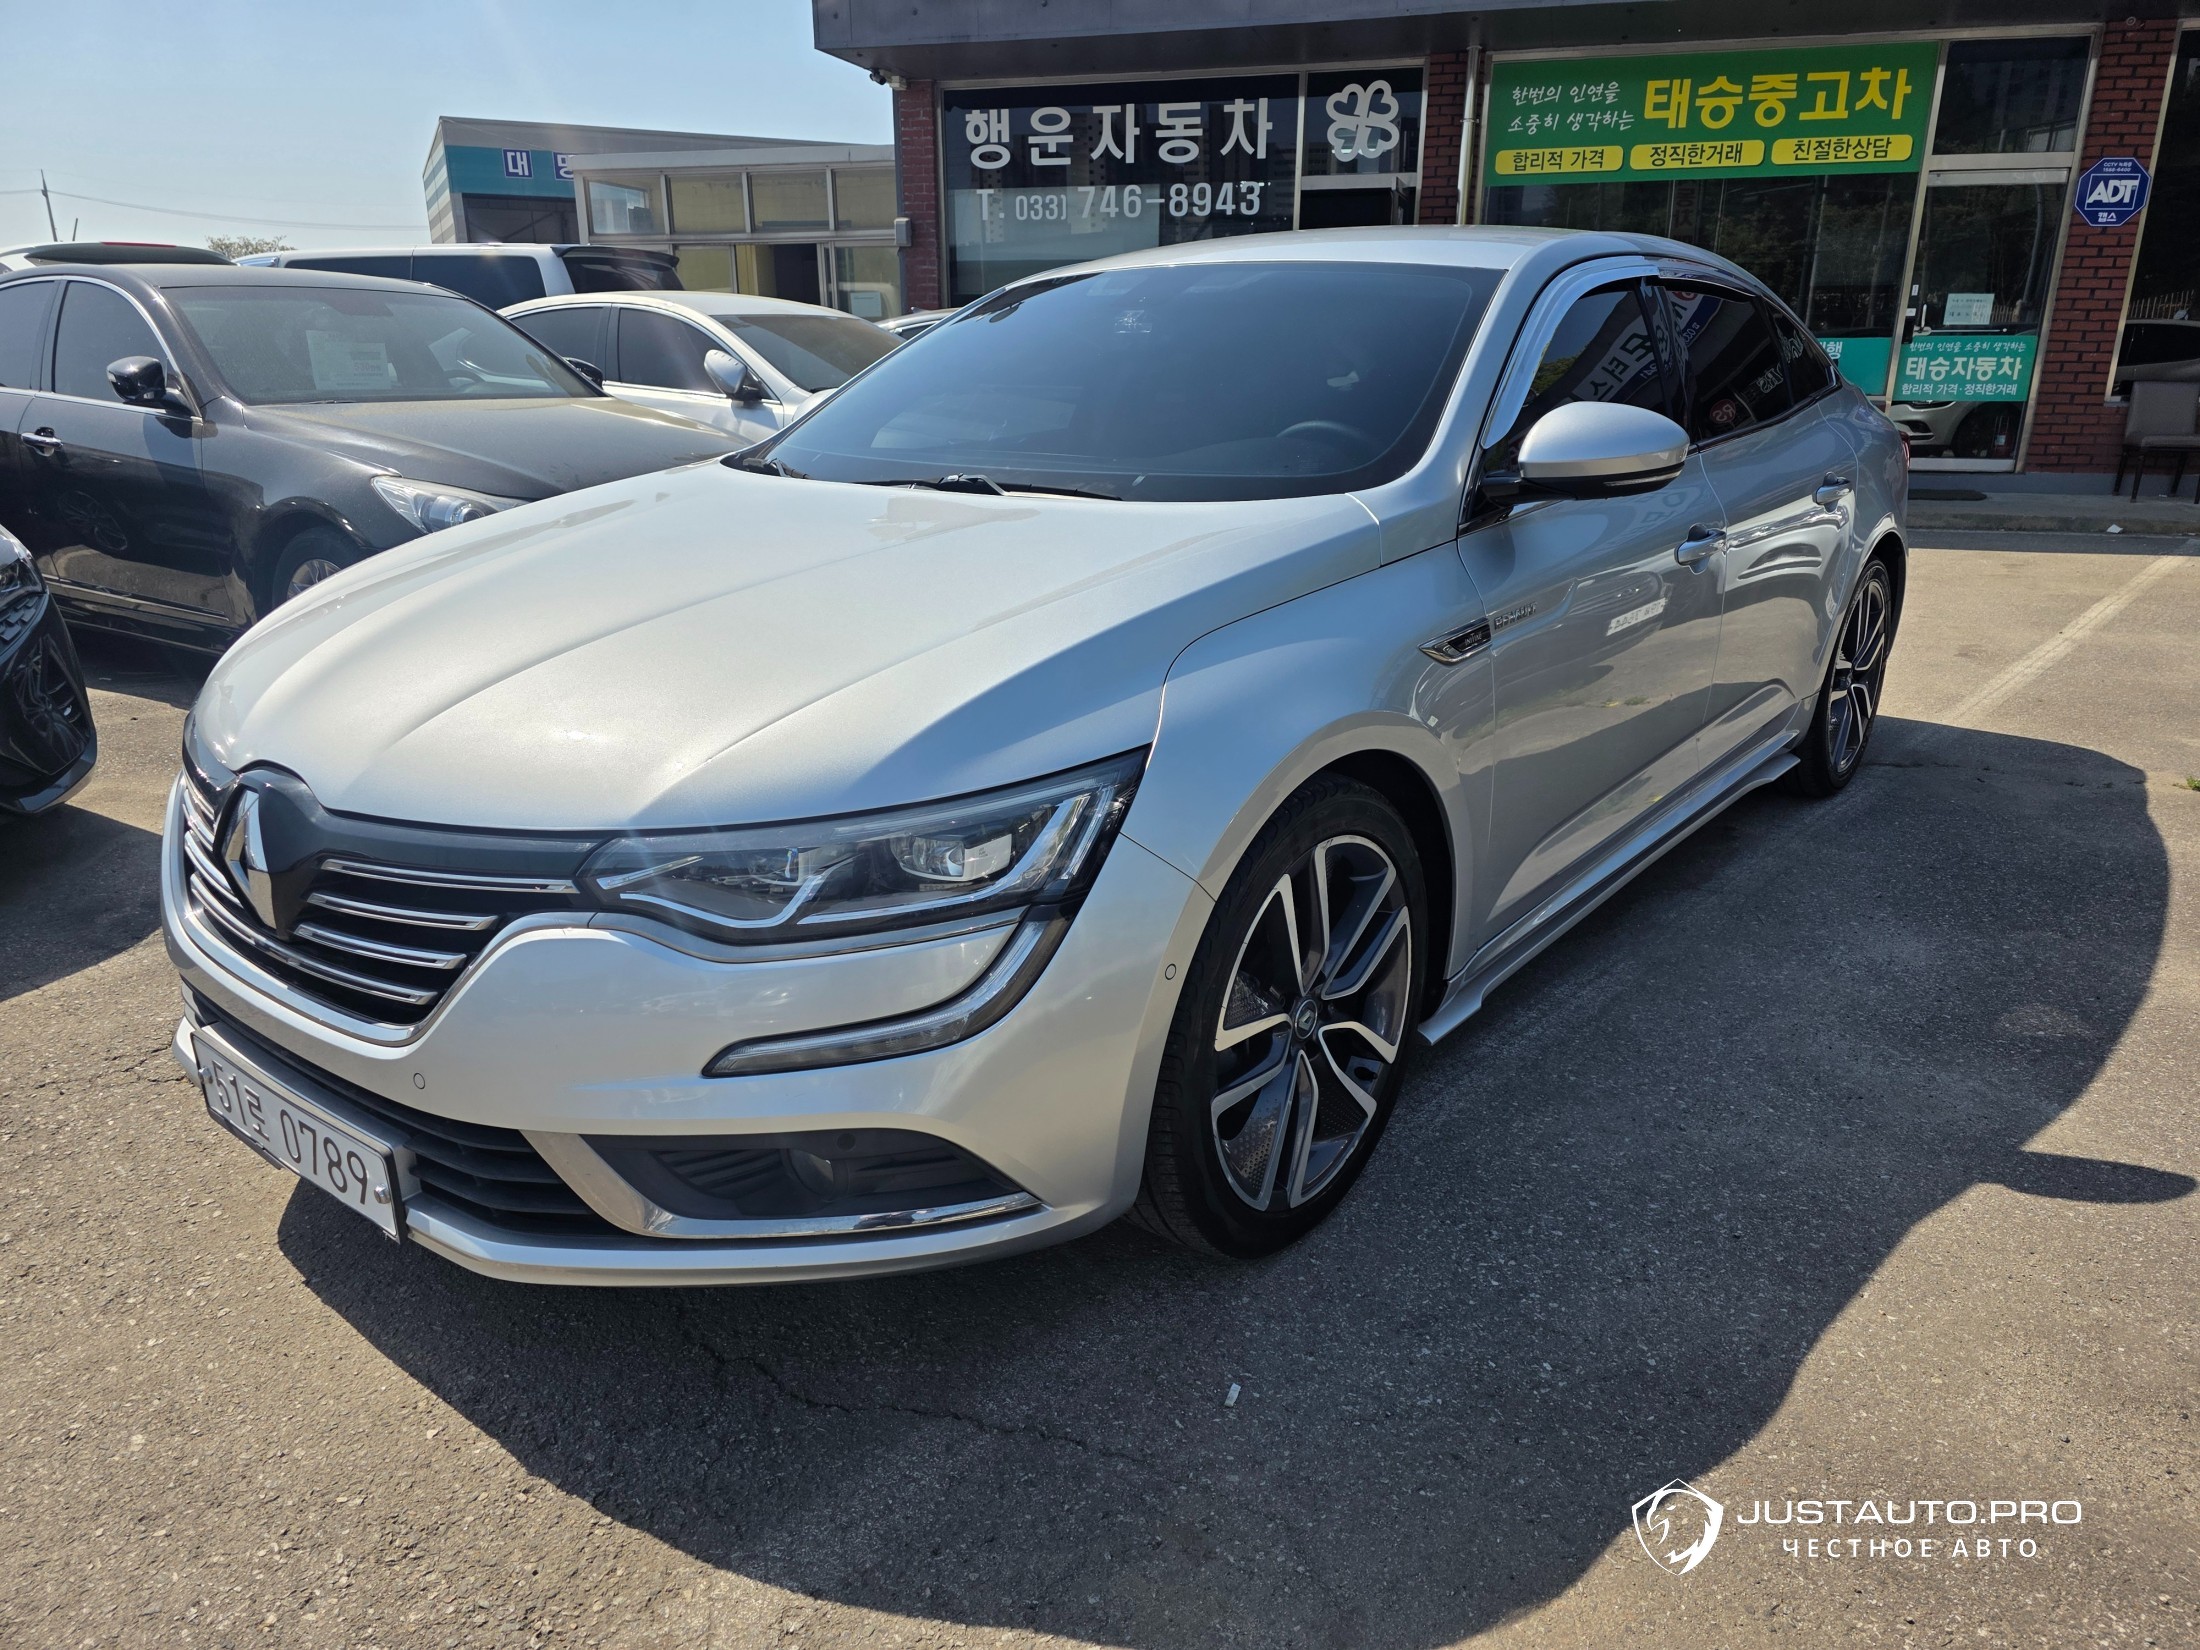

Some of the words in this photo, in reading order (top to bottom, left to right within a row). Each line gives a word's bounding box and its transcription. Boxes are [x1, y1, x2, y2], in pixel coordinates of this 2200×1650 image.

[1512, 85, 1562, 106] 한번의
[1569, 81, 1621, 104] 인연을
[1644, 67, 1912, 129] 태승중고차
[965, 97, 1273, 169] 행운자동차
[1507, 113, 1560, 135] 소중히
[1566, 110, 1635, 132] 생각하는
[1512, 151, 1564, 172] 합리적
[1569, 149, 1605, 170] 가격
[1649, 141, 1743, 166] 정직한거래
[1791, 137, 1892, 162] 친절한상담
[1077, 181, 1261, 220] 746-8943
[2087, 179, 2139, 203] ADT
[2098, 212, 2116, 222] 캡스
[1910, 342, 1934, 352] 한번의
[1937, 342, 1962, 353] 인연을
[1964, 341, 1990, 352] 소중히
[1993, 341, 2027, 352] 생각하는
[1906, 356, 2023, 381] 태승자동차
[1901, 383, 1934, 395] 합리적
[211, 1059, 270, 1143] 51로
[279, 1108, 368, 1206] 0789
